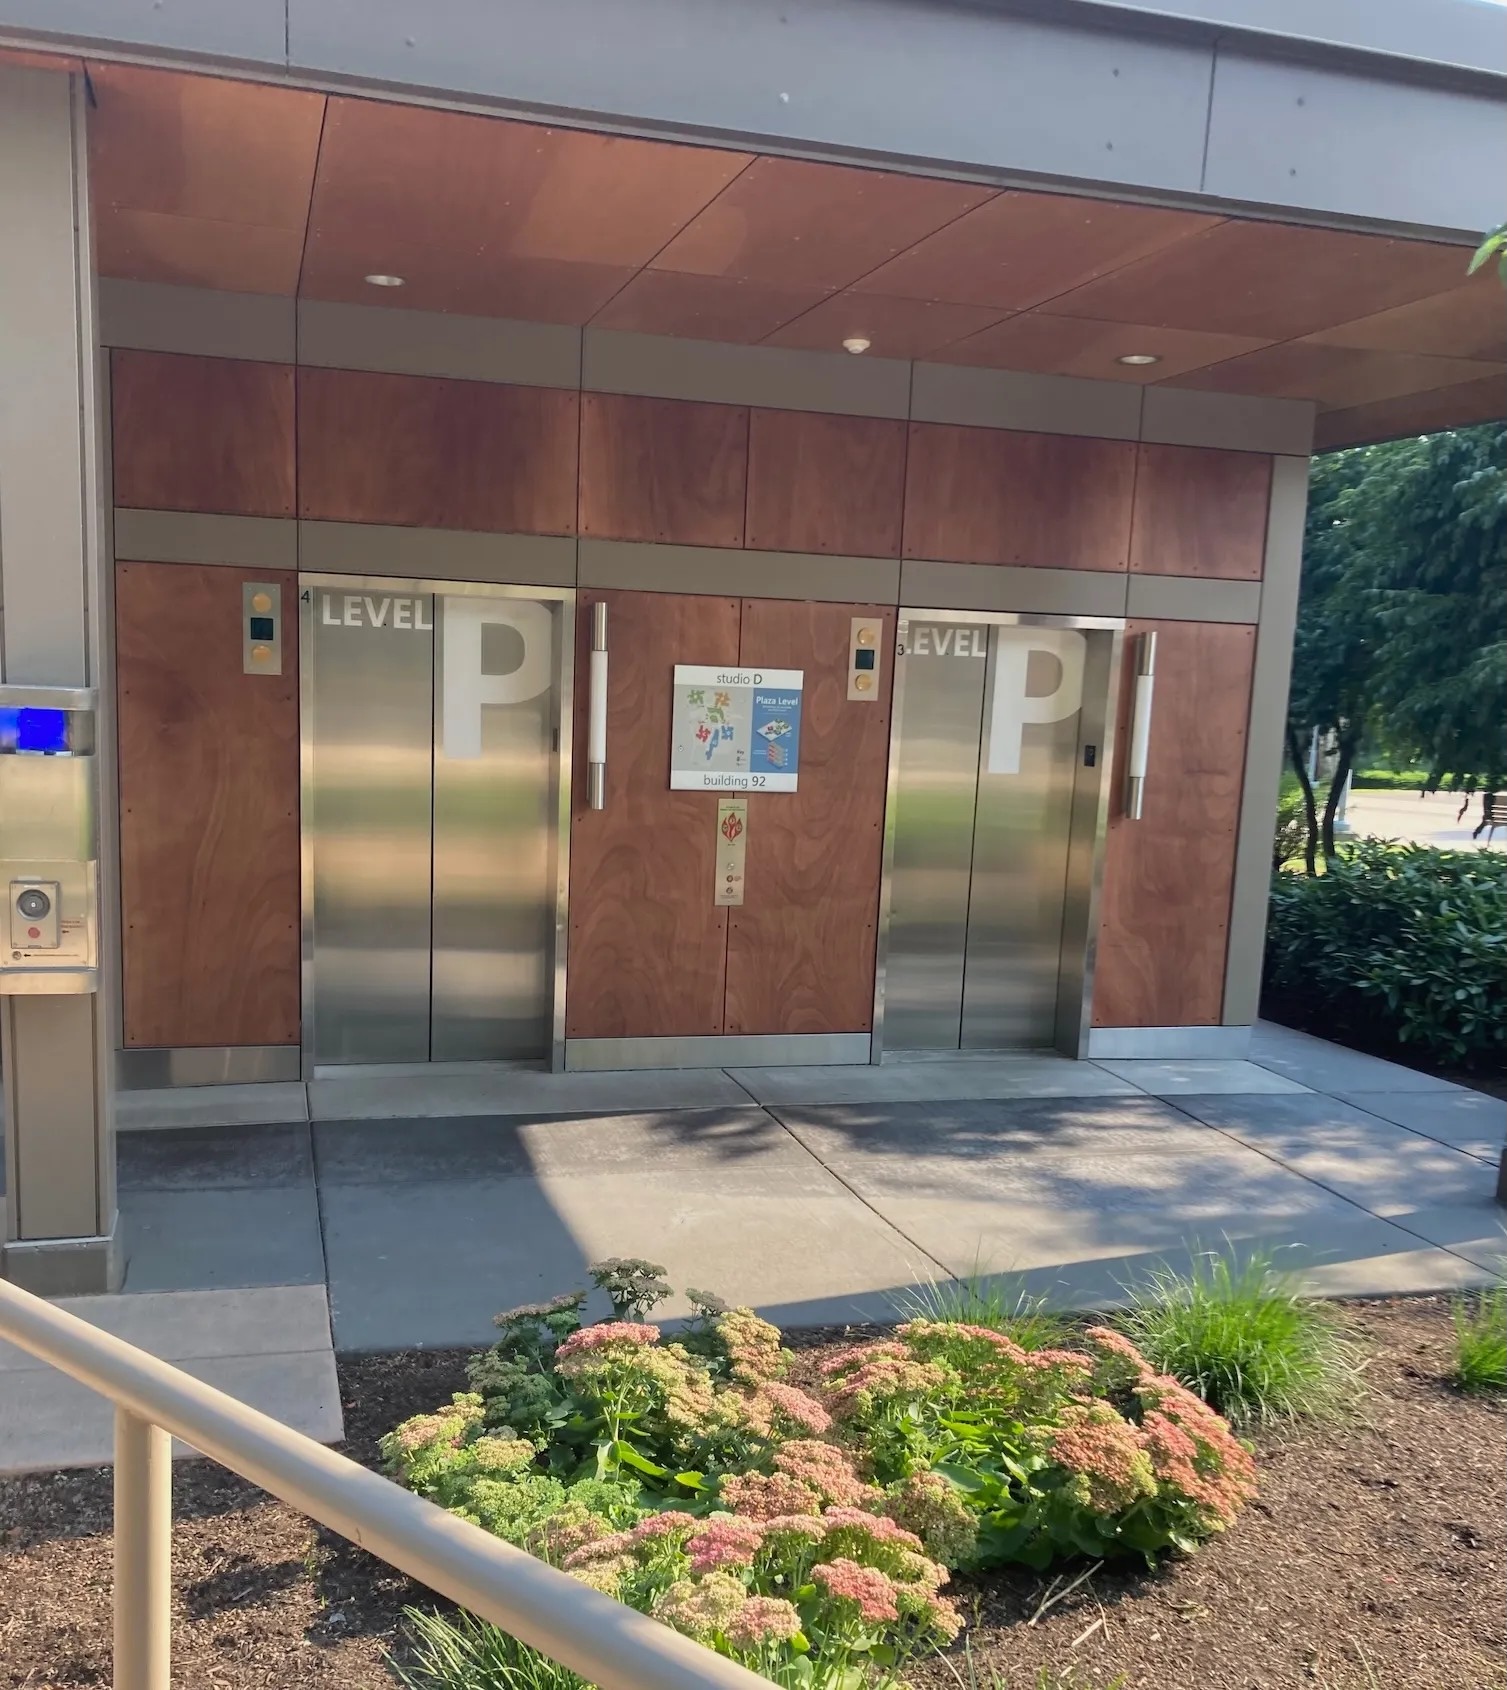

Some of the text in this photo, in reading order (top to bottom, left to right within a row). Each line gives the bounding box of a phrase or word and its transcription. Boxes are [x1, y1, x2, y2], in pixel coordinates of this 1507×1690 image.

[301, 590, 310, 603] 4
[897, 644, 905, 656] 3
[322, 594, 552, 760] LEVEL P
[716, 673, 763, 685] studio D
[756, 696, 799, 706] Plaza Level
[906, 627, 1086, 774] EVEL P
[703, 774, 766, 789] building 92
